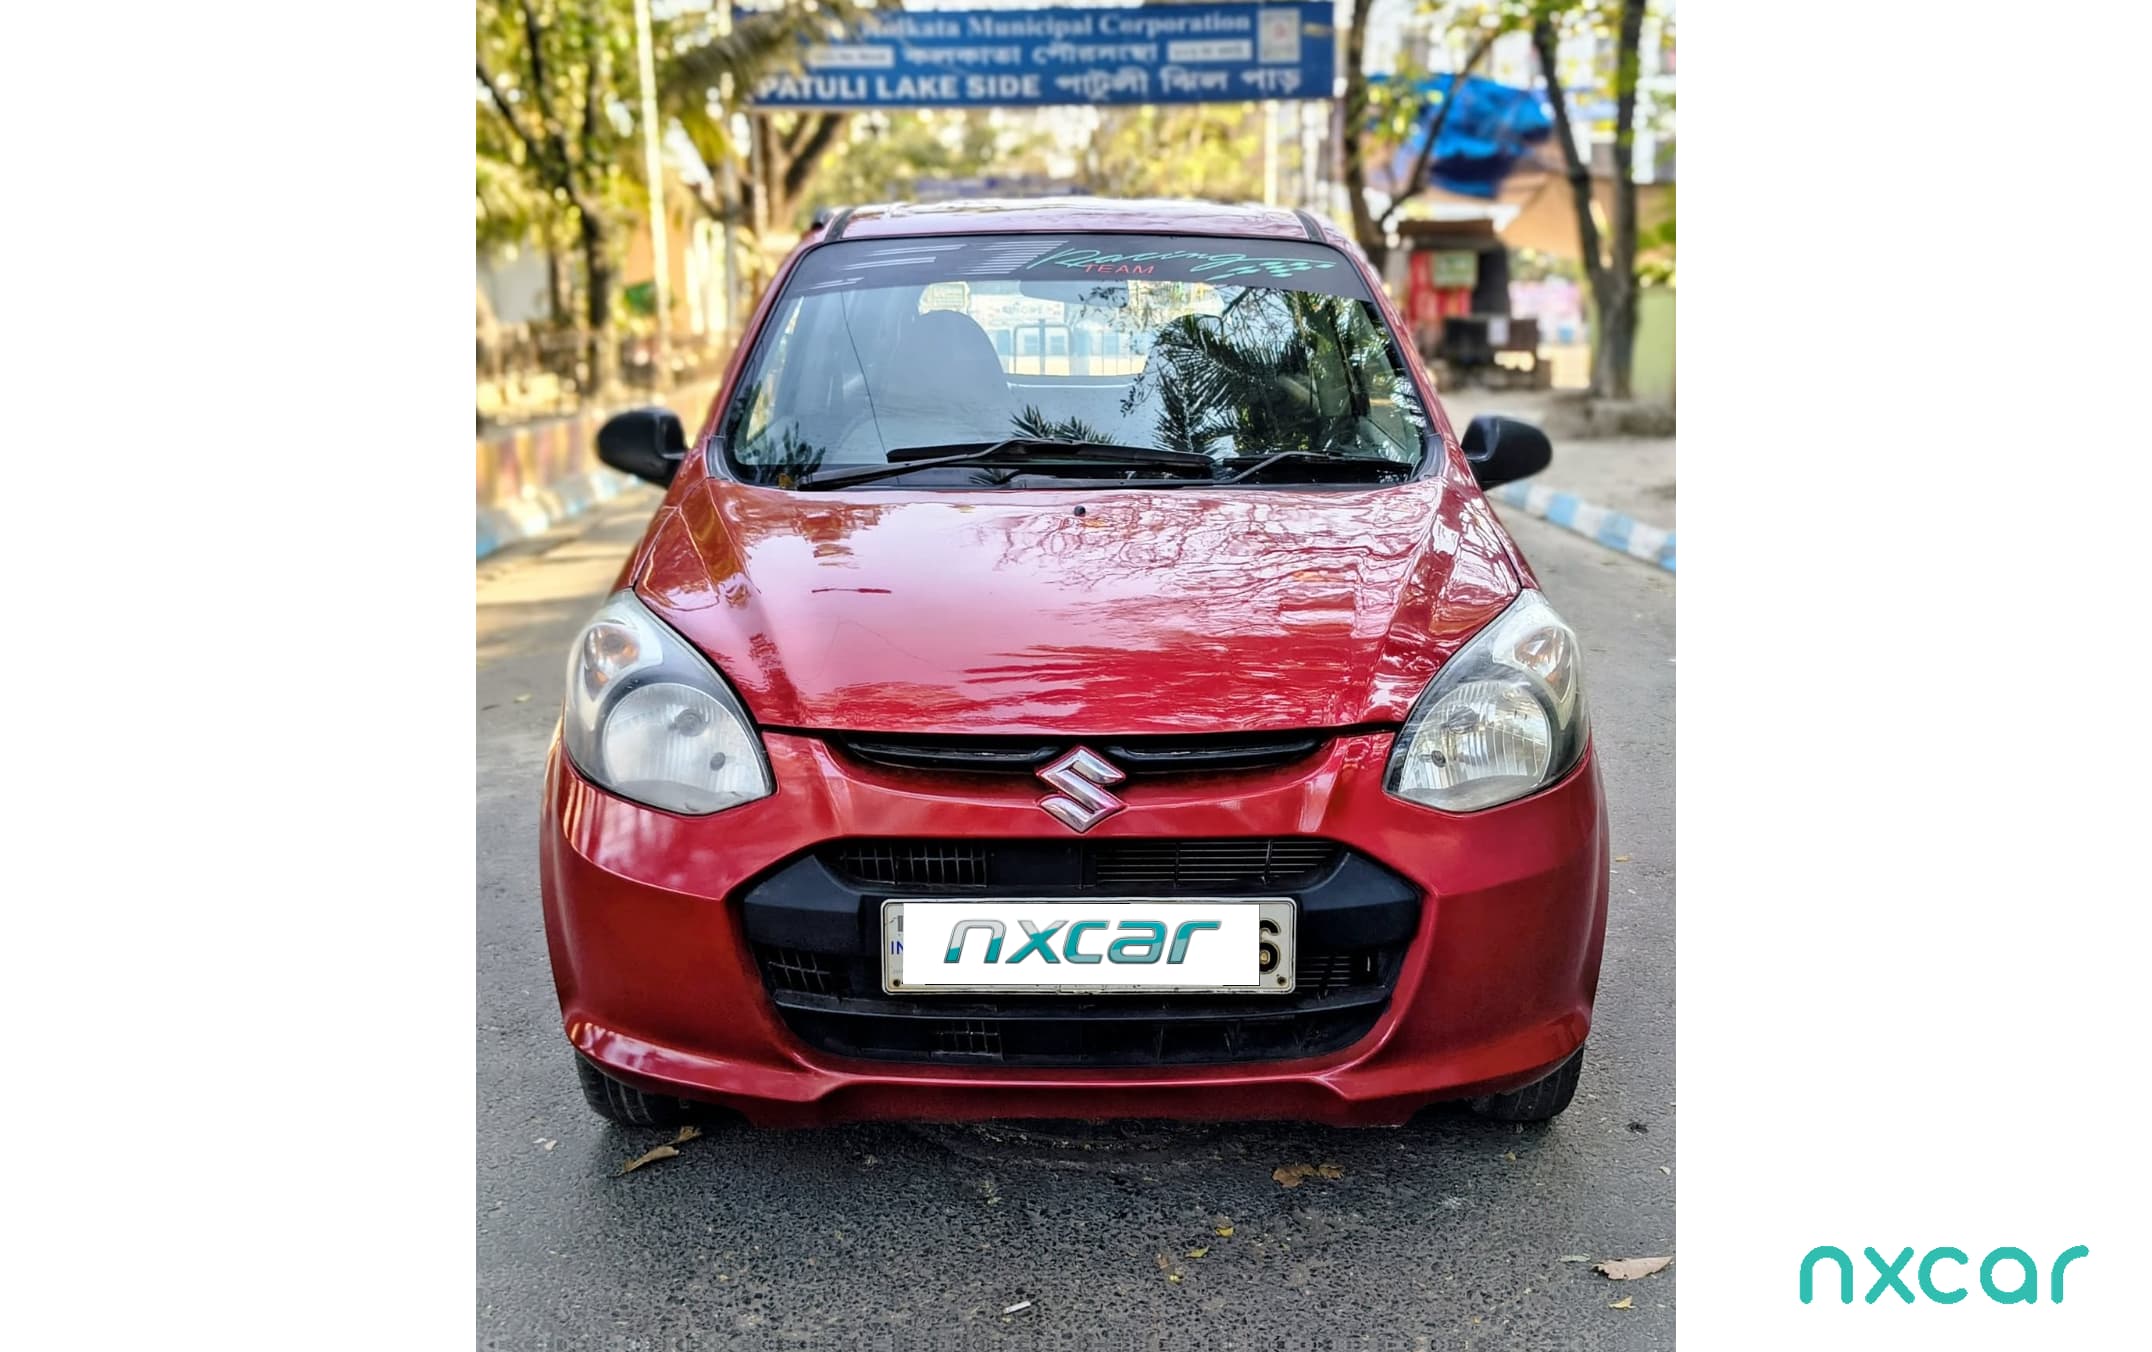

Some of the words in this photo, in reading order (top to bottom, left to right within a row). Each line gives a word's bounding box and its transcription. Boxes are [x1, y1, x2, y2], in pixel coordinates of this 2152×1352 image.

[967, 15, 1093, 38] Municipal
[1099, 13, 1251, 38] Corporation
[756, 75, 868, 99] PATULI
[875, 75, 957, 99] LAKE
[966, 74, 1041, 98] SIDE
[1026, 247, 1249, 273] Racing
[1084, 263, 1154, 274] TEAM
